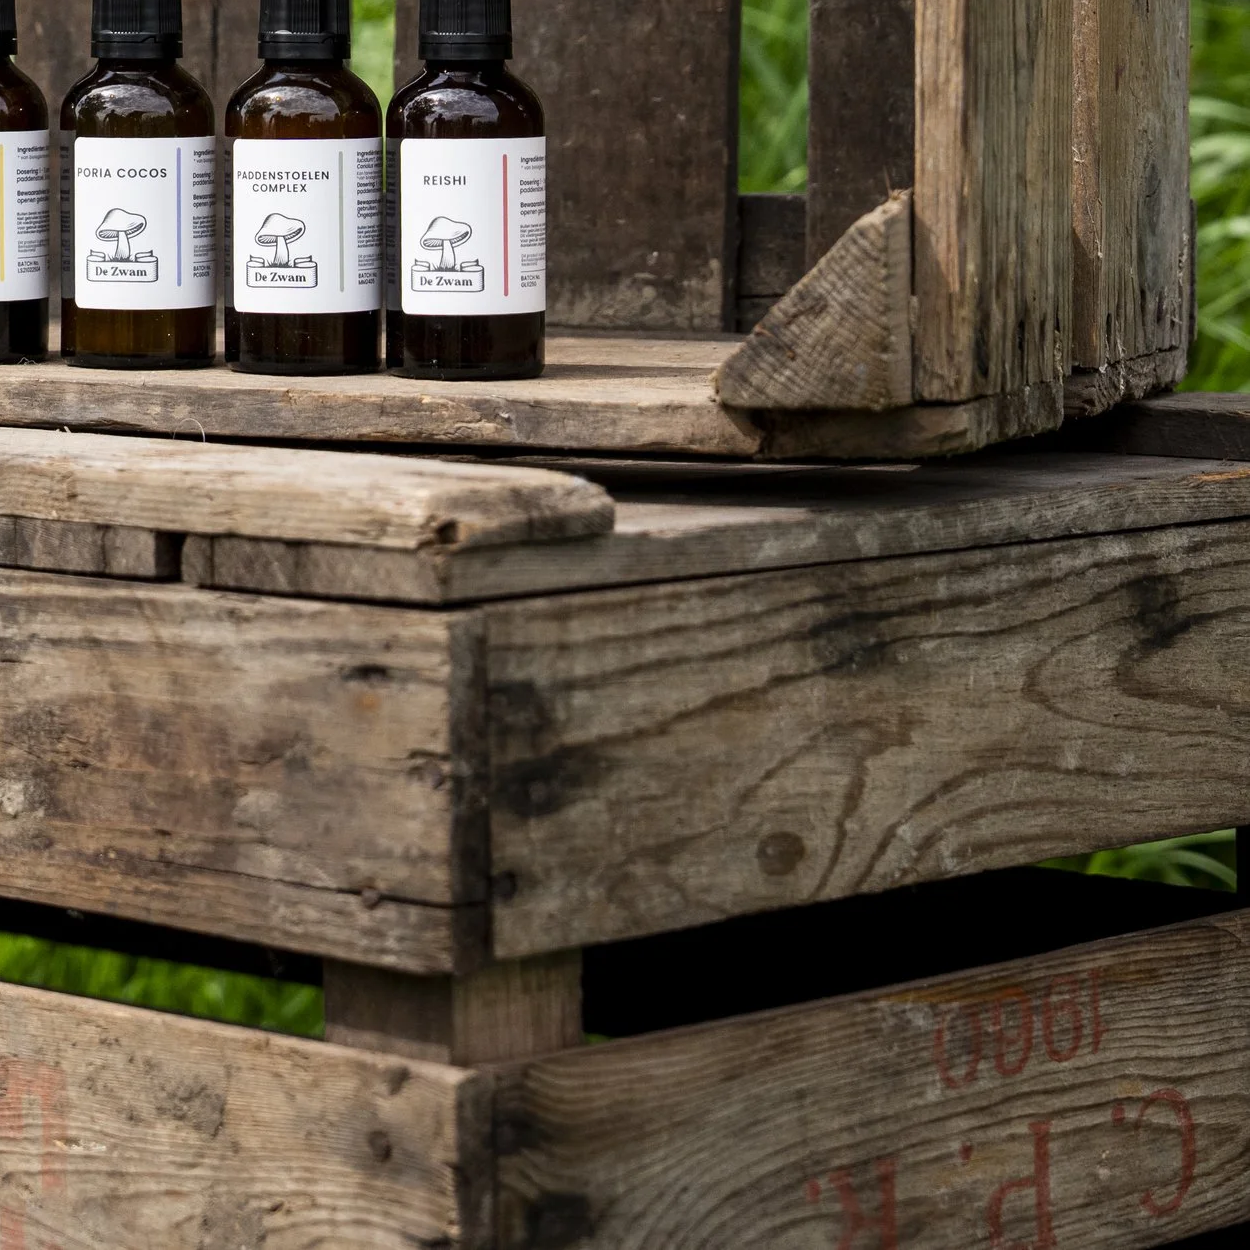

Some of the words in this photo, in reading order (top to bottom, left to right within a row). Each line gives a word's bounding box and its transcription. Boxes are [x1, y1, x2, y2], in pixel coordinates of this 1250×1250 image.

[77, 168, 111, 178] PORIA
[117, 168, 167, 178] COCOS
[237, 170, 330, 180] PADDENSTOELEN
[423, 175, 466, 185] REISHI
[252, 183, 307, 193] COMPLEX
[95, 266, 108, 276] De
[111, 266, 147, 276] Zwam
[255, 272, 267, 282] De
[270, 272, 306, 282] Zwam
[420, 276, 432, 286] De
[435, 276, 473, 286] Zwam
